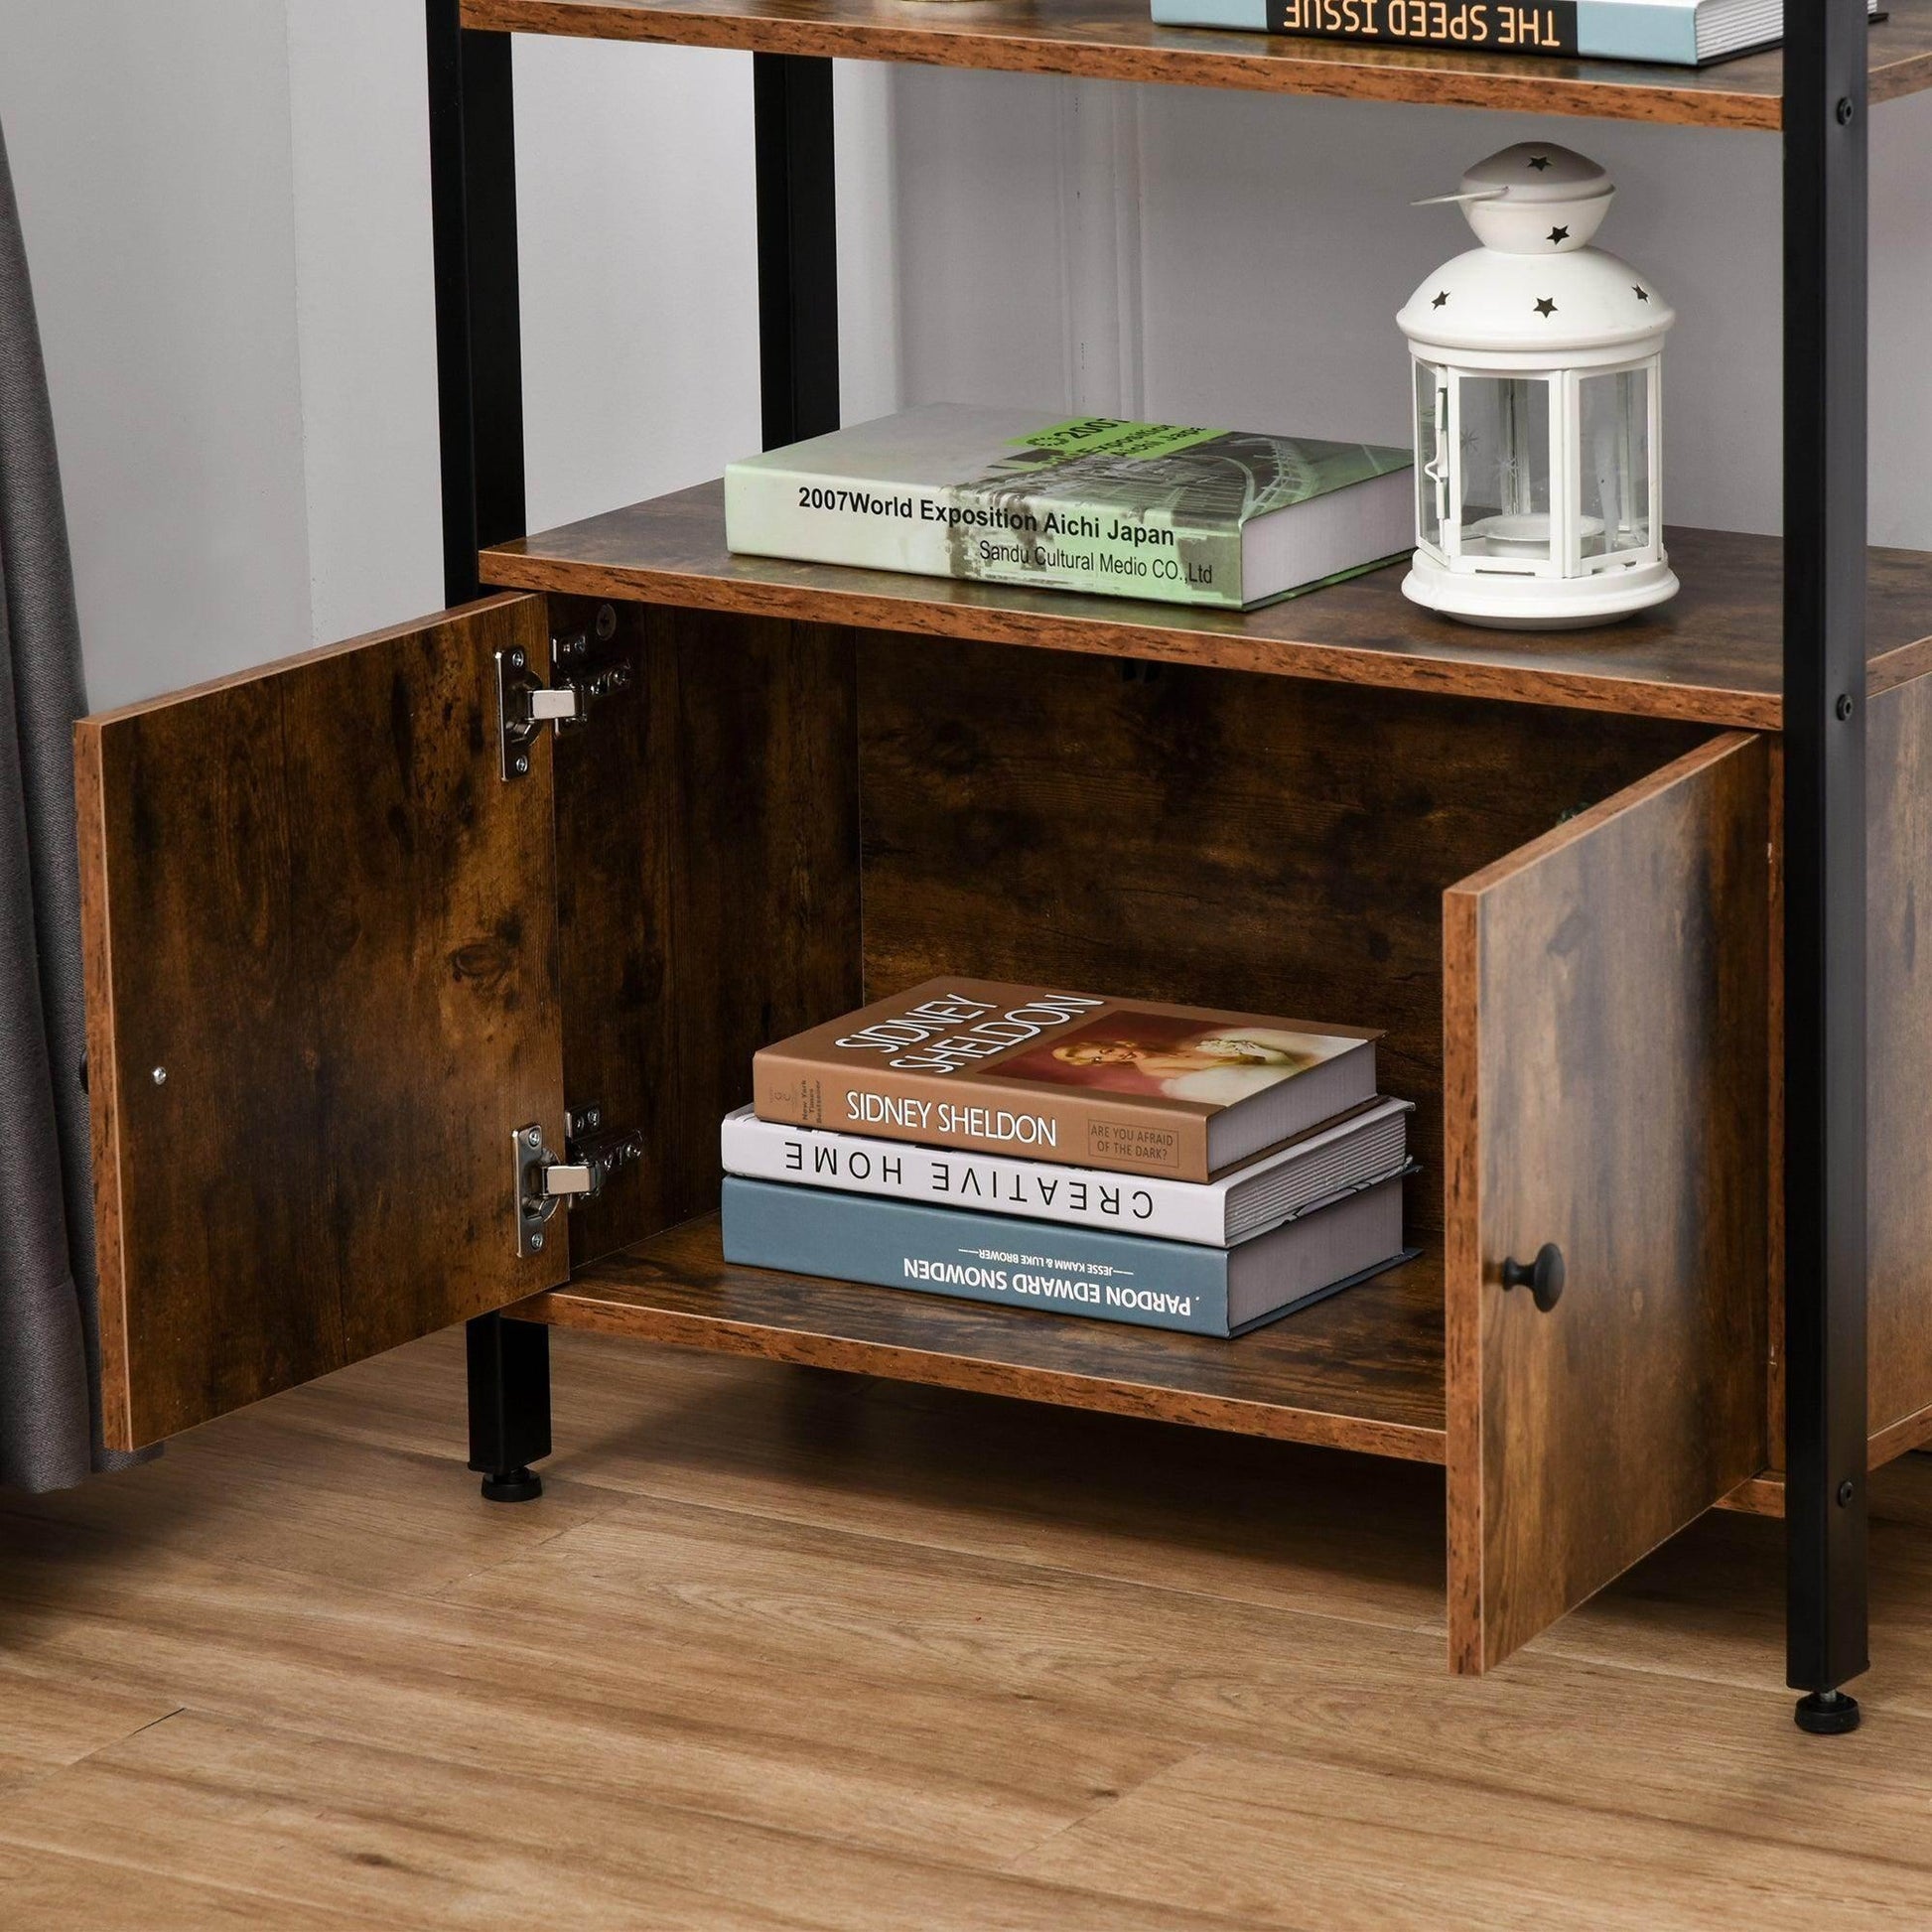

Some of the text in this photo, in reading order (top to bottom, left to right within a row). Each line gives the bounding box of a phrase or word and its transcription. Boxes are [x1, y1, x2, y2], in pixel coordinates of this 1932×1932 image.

[1284, 0, 1560, 47] THE SPEED ISSUE
[798, 486, 1174, 547] 2007World Exposition Aichi Japan
[979, 540, 1030, 564] Sandu
[1035, 546, 1094, 571] Cultural
[1100, 553, 1147, 577] Medio
[835, 993, 999, 1053] SIDNEY
[890, 994, 1104, 1073] SHELDON
[846, 1090, 1056, 1147] SIDNEY SHELDON
[1091, 1125, 1173, 1147] ARE YOU AFRAID
[1097, 1141, 1168, 1161] OF THE DARK?
[784, 1142, 1154, 1220] CREATIVE HOME
[903, 1258, 1007, 1290] SNOWDEN
[978, 1249, 1114, 1277] JESSE KAMM & LUKE BROWER
[1013, 1274, 1101, 1303] EDWARD
